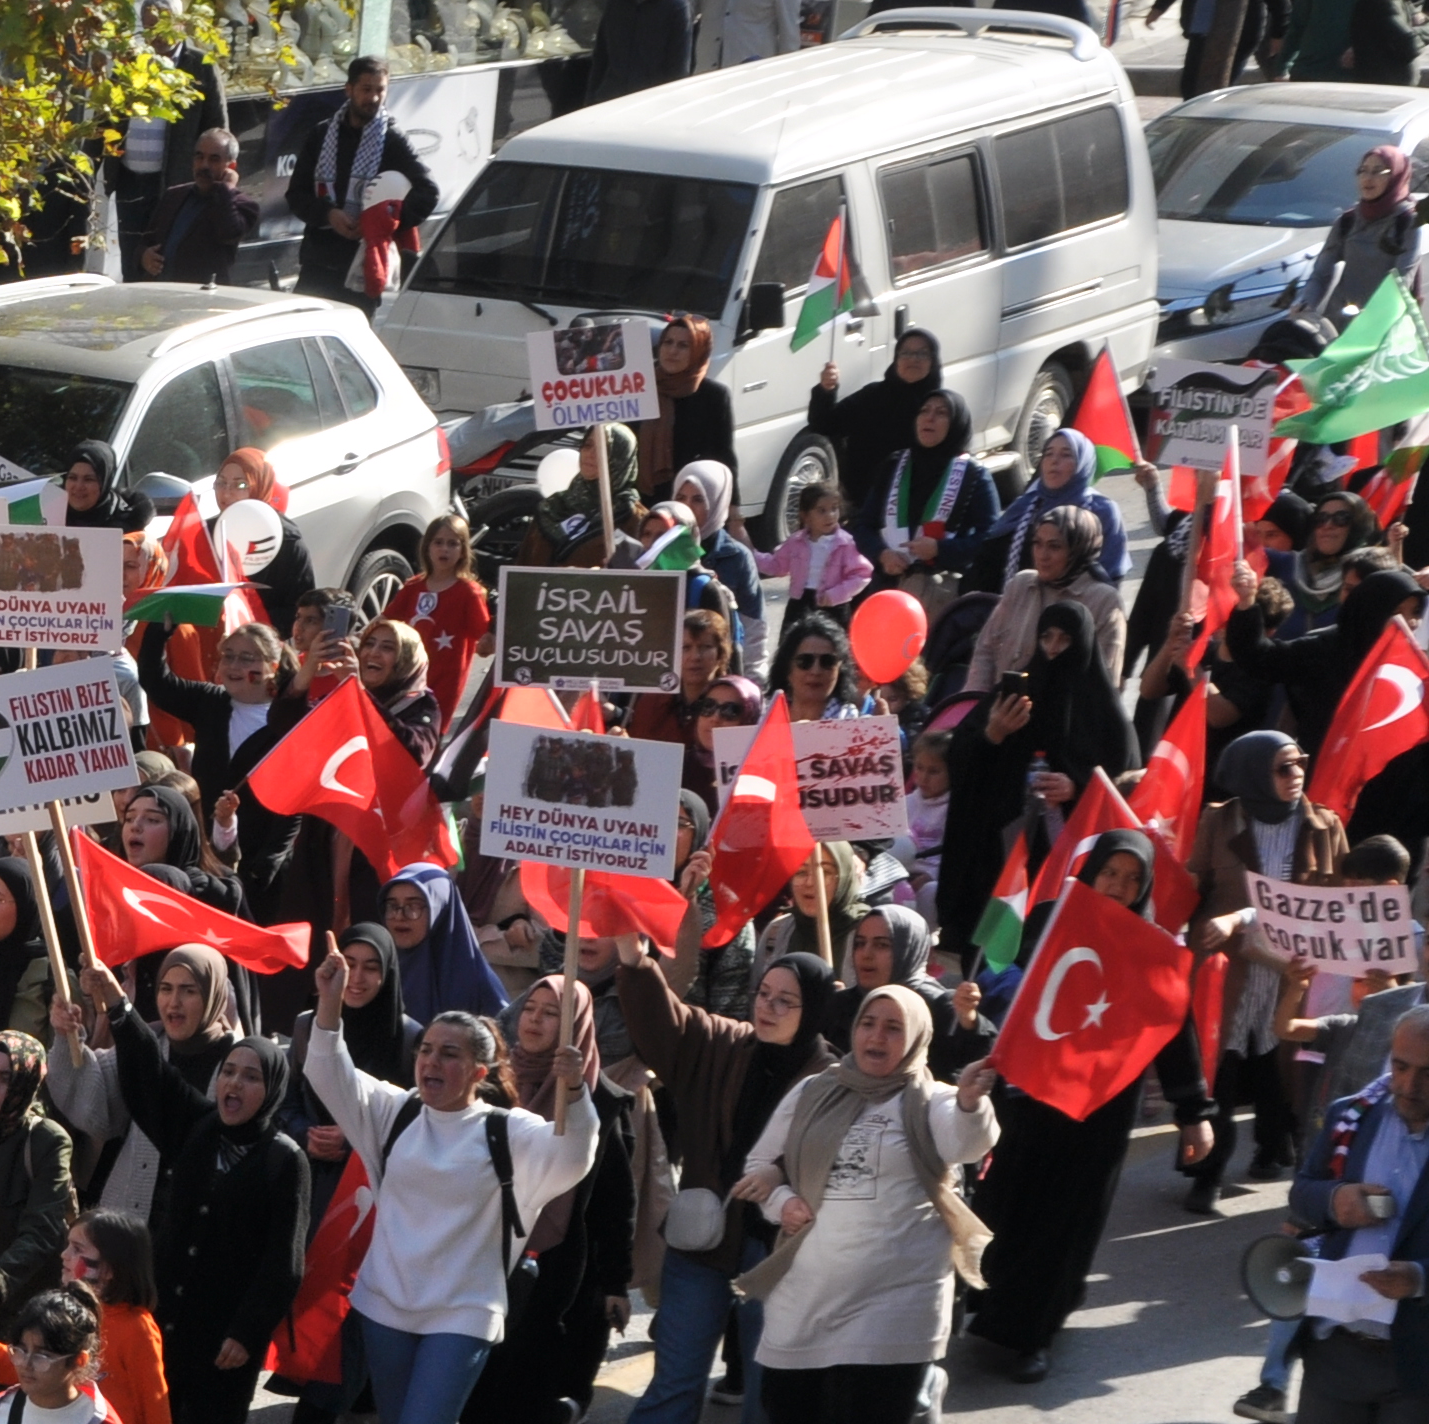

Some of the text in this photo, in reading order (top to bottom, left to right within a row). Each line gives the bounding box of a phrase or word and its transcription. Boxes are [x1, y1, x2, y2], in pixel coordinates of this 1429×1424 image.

[542, 371, 646, 408] ÇOCUKLAR
[1158, 386, 1268, 421] FİLİSTİN'DE
[553, 395, 640, 426] ÖLMESİN
[1240, 429, 1264, 450] AR
[56, 601, 106, 615] UYAN!
[536, 582, 648, 615] İSRAİL
[9, 615, 83, 630] ÇOCUKLAR
[86, 617, 114, 631] İÇİN
[25, 628, 98, 645] İSTİYORUZ
[538, 616, 644, 646] SAVAŞ
[508, 646, 670, 668] SUÇLUSUDUR
[24, 743, 129, 785] KADAR YAKIN
[810, 755, 896, 779] SAVAŞ
[499, 804, 659, 839] HEY DÜNYA UYAN!
[490, 818, 666, 860] FİLİSTİN ÇOCUKLAR İÇİN
[505, 839, 649, 870] ADALET İSTİYORUZ
[1256, 879, 1401, 923] Gazze'de
[1263, 922, 1409, 962] çocuk var
